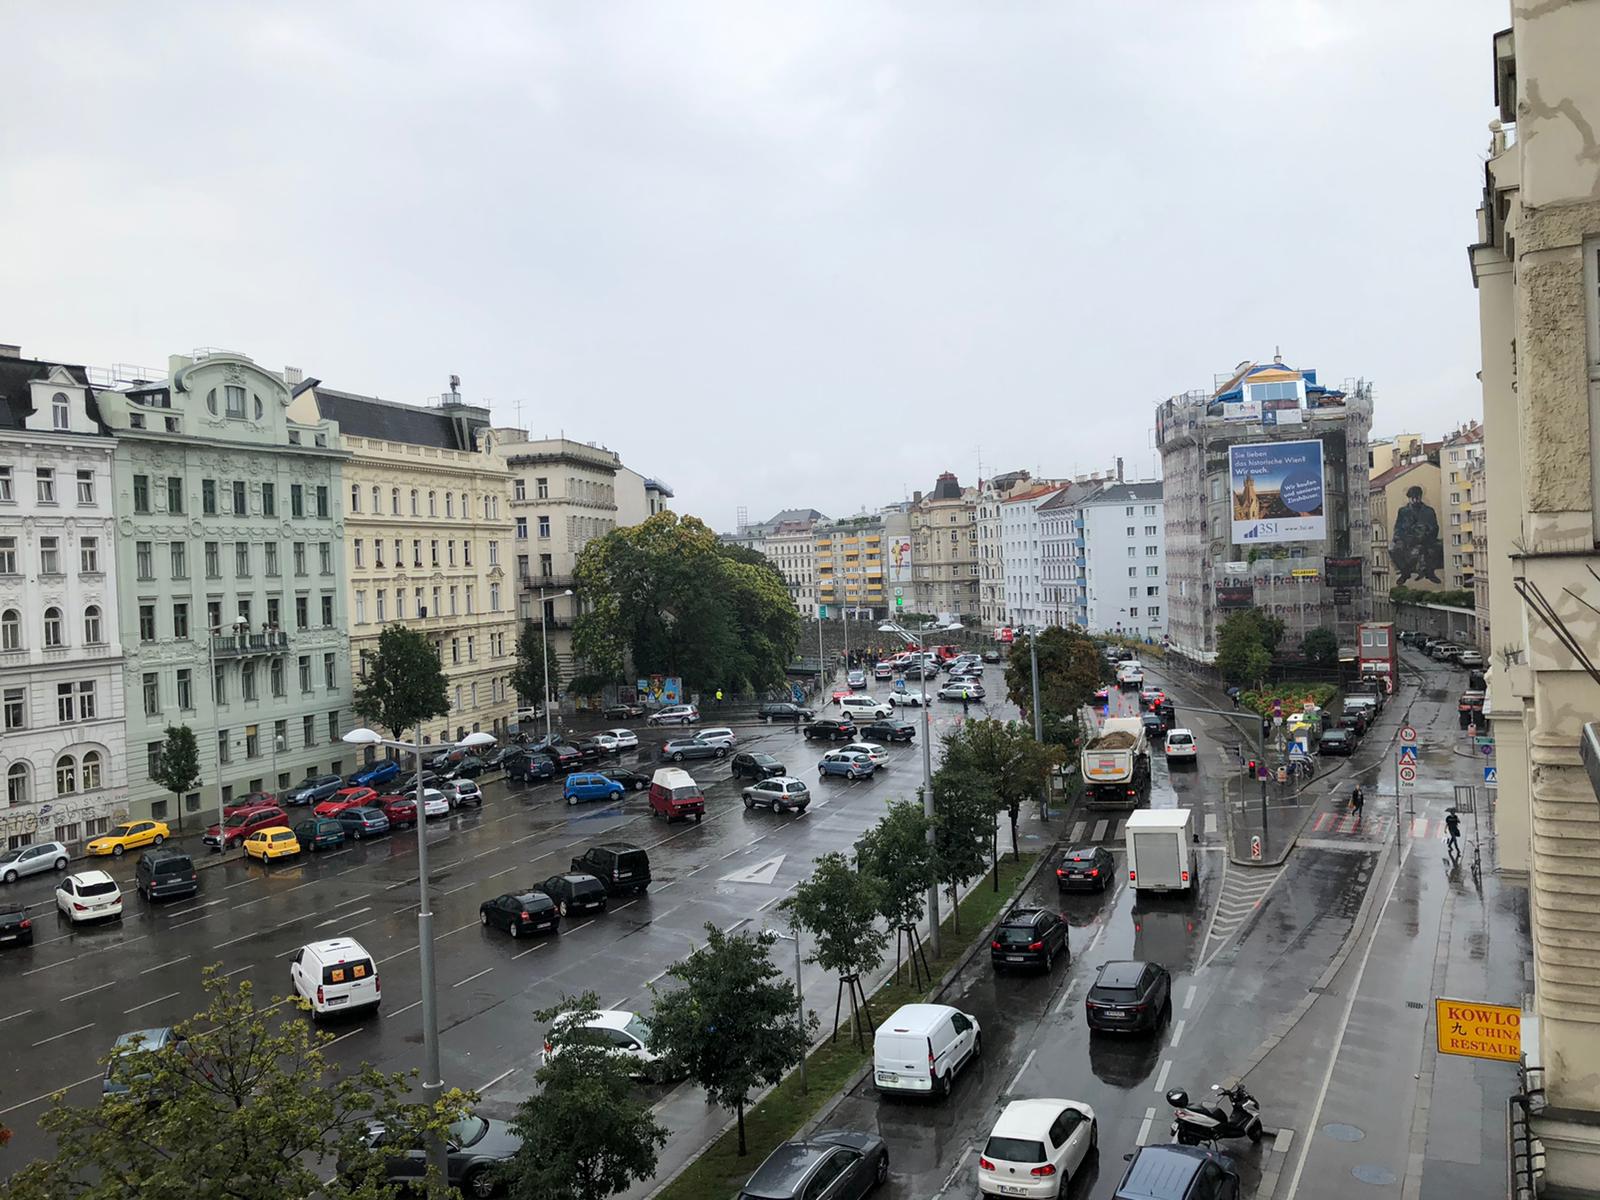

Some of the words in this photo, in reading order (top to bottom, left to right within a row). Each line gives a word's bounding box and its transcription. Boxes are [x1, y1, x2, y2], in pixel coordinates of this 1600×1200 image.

[1234, 451, 1245, 459] Sie
[1248, 457, 1282, 466] historische
[1235, 467, 1248, 475] Wir
[1296, 480, 1317, 488] kaufen
[1296, 486, 1321, 495] sanieren
[1259, 523, 1278, 534] 3SI
[1451, 1022, 1467, 1036] 九
